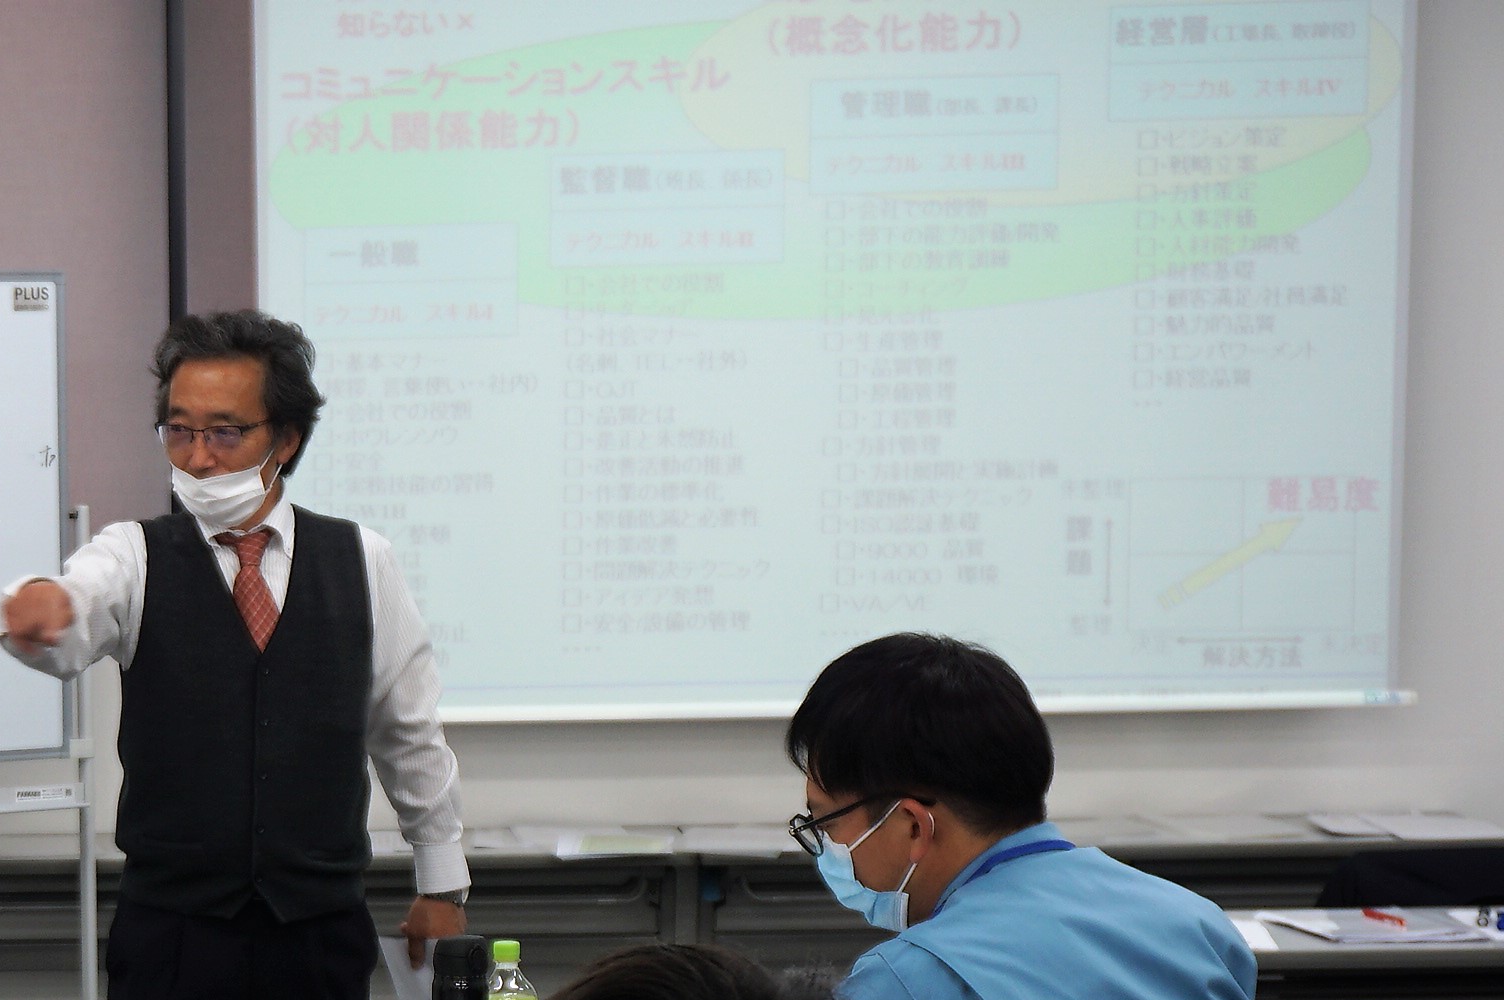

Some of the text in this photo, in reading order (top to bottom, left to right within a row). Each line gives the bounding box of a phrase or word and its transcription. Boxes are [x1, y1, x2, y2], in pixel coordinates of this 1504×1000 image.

[281, 56, 730, 100] コミュニケーションスキル
[329, 240, 419, 268] 一般職
[15, 286, 49, 300] PLUS
[1267, 476, 1380, 513] 難易度
